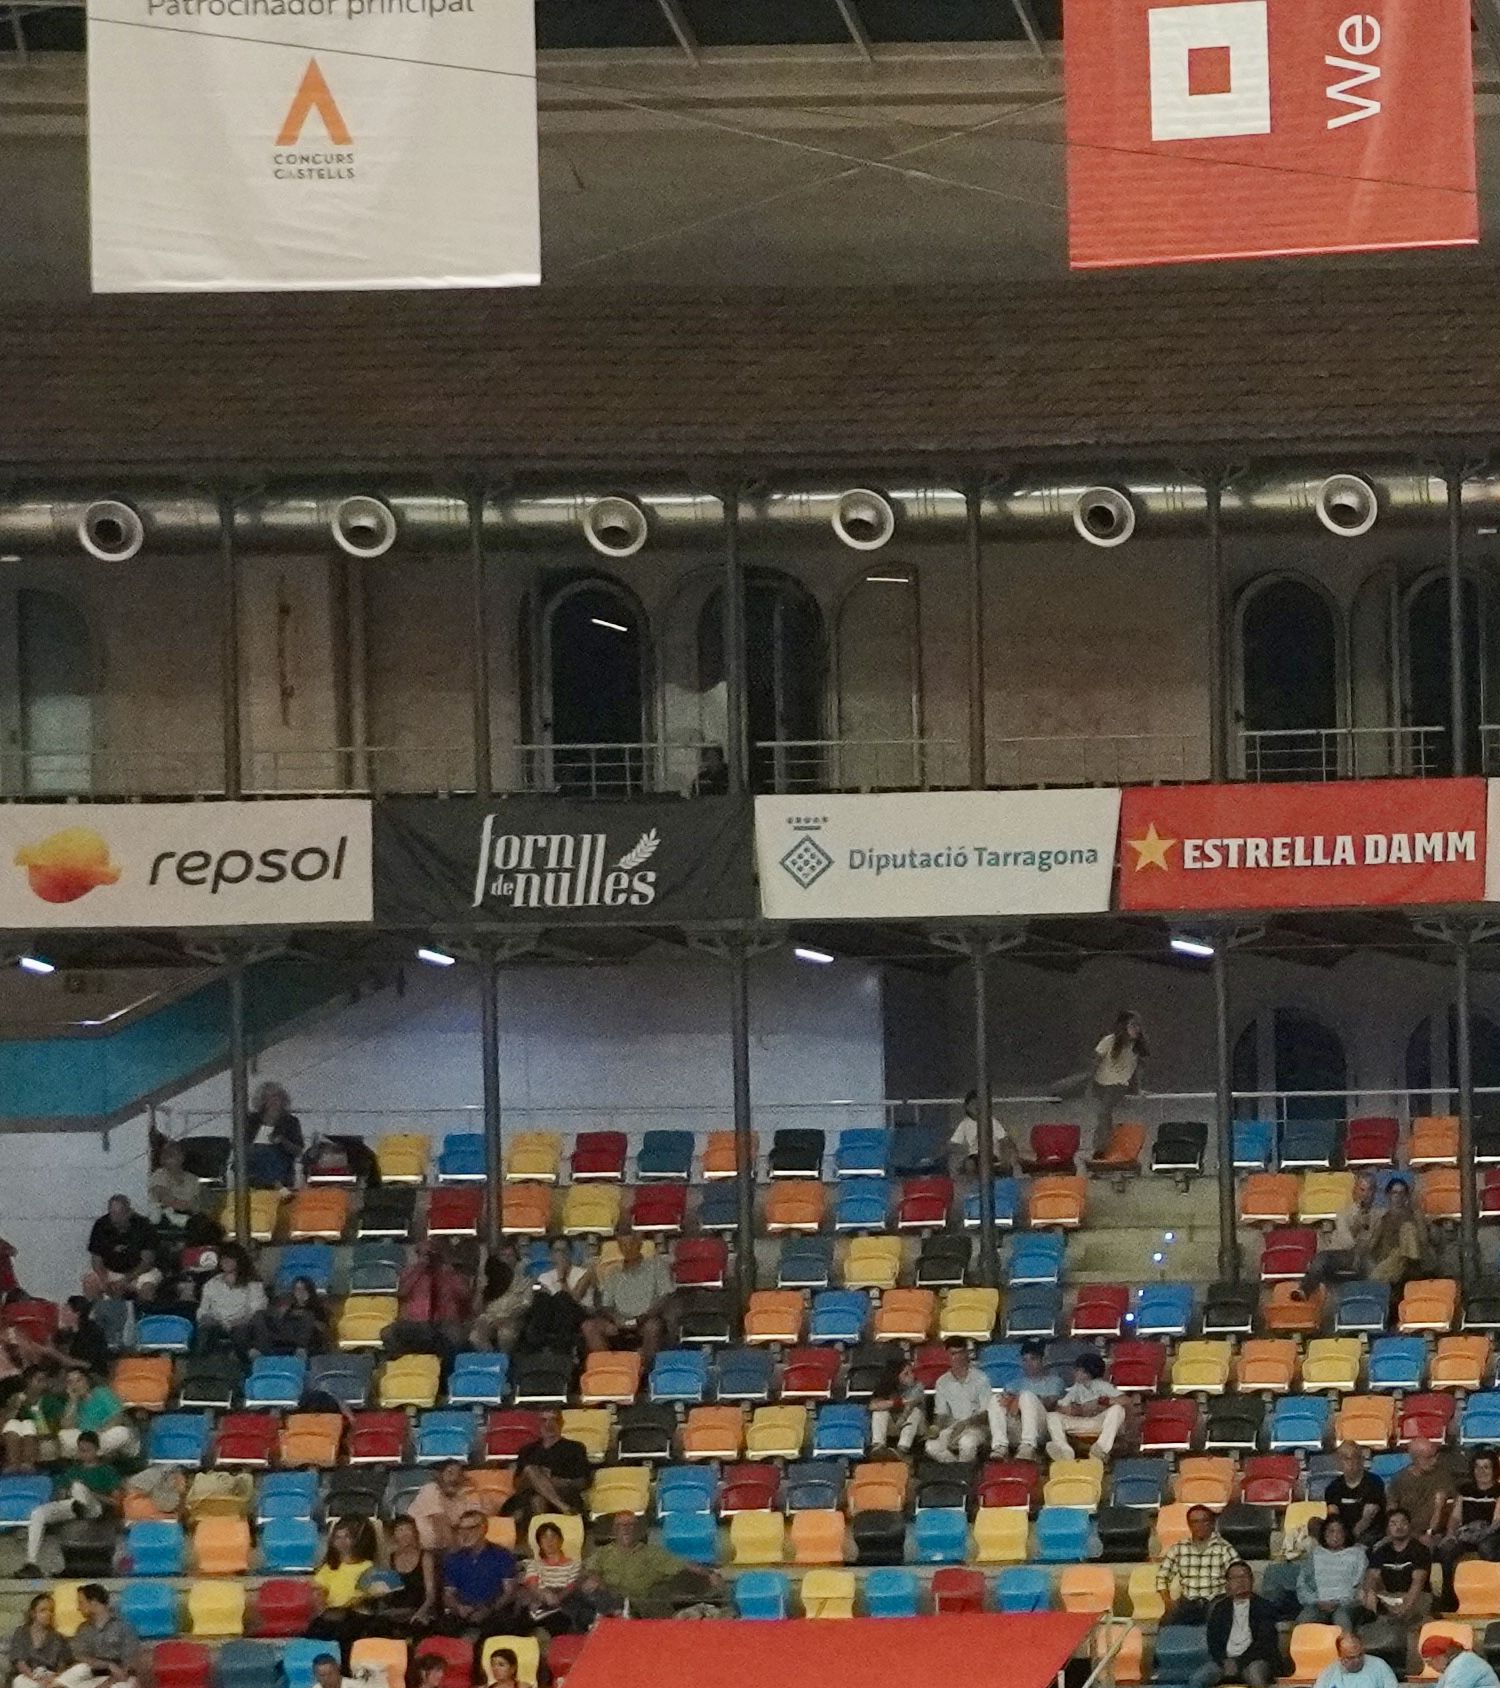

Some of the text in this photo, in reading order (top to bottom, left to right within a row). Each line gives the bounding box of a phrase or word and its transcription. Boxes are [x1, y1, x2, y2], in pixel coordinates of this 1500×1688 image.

[1326, 12, 1382, 130] We
[274, 153, 355, 165] CONCURS
[274, 168, 355, 180] CASTELLS
[148, 836, 349, 893] repsol
[849, 845, 1098, 875] Diputació Tarragona
[1183, 830, 1476, 871] ESTRELLA DAMM
